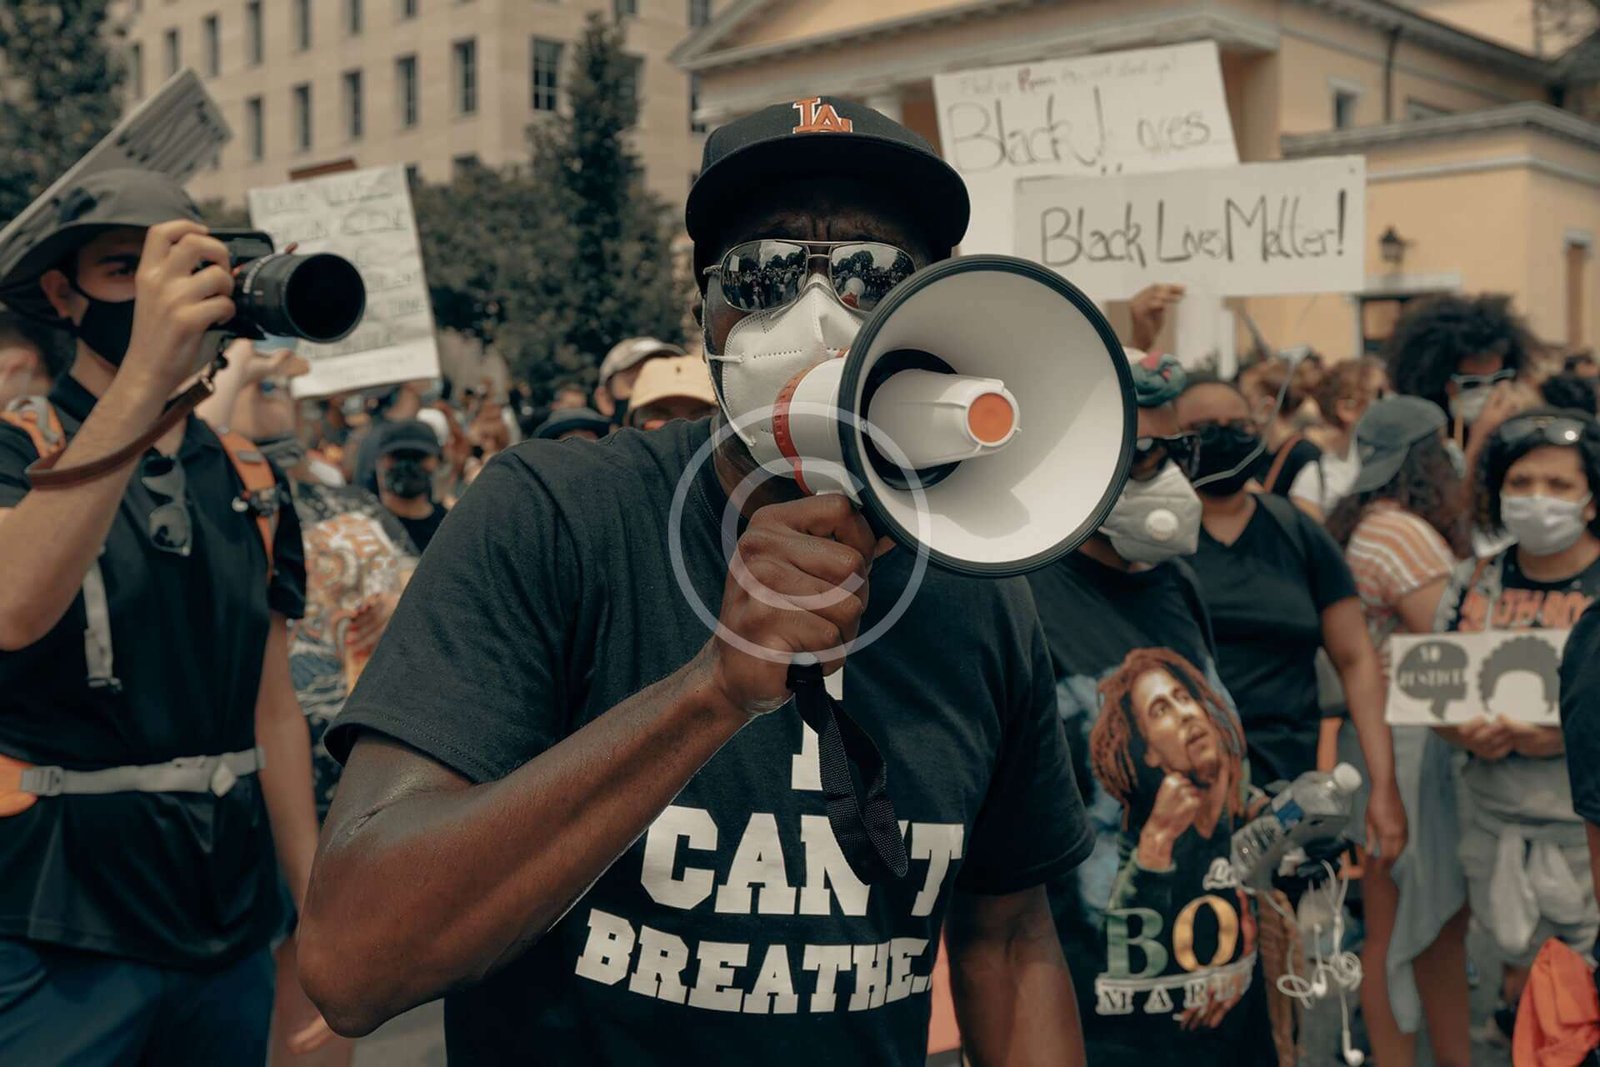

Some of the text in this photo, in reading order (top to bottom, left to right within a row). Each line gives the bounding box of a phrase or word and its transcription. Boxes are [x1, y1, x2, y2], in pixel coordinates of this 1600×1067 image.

[792, 96, 853, 134] LA
[946, 93, 1097, 174] Black
[1040, 202, 1147, 269] Black
[1103, 894, 1257, 980] BO
